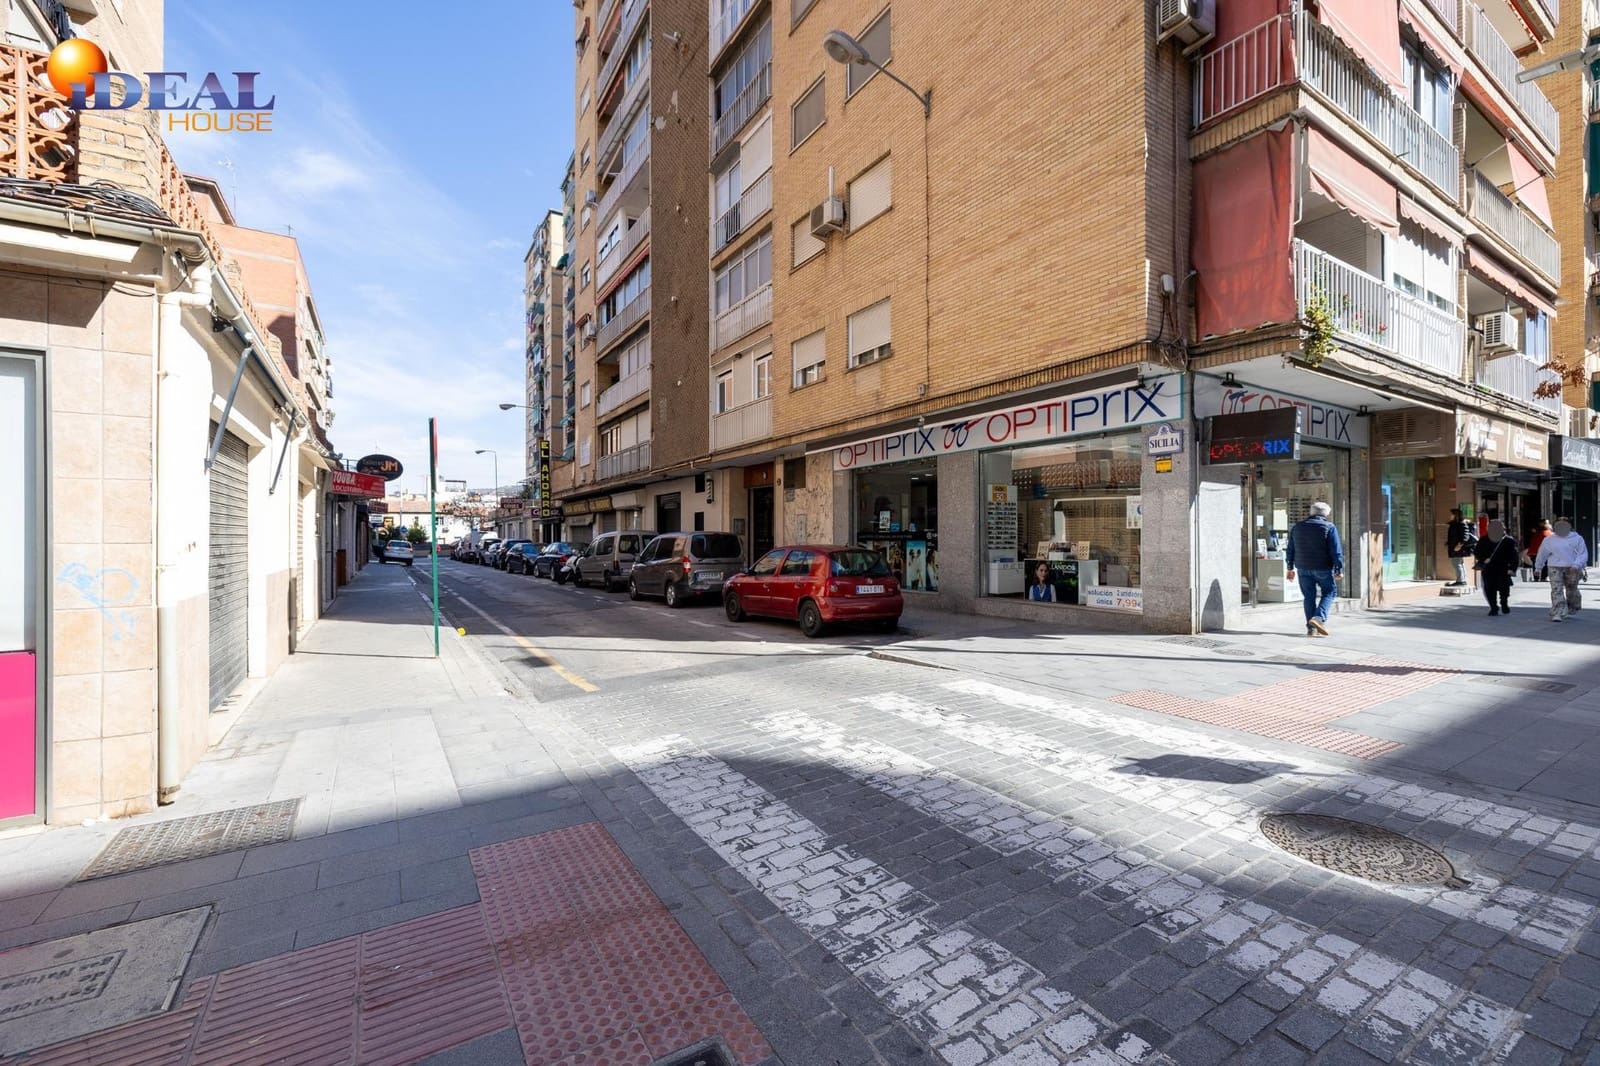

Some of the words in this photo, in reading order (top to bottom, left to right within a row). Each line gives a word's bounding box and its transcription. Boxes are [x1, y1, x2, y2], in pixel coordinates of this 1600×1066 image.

[540, 441, 549, 458] EL
[1149, 437, 1179, 449] SICILIA
[380, 460, 398, 472] JM
[541, 464, 550, 517] AHORRO
